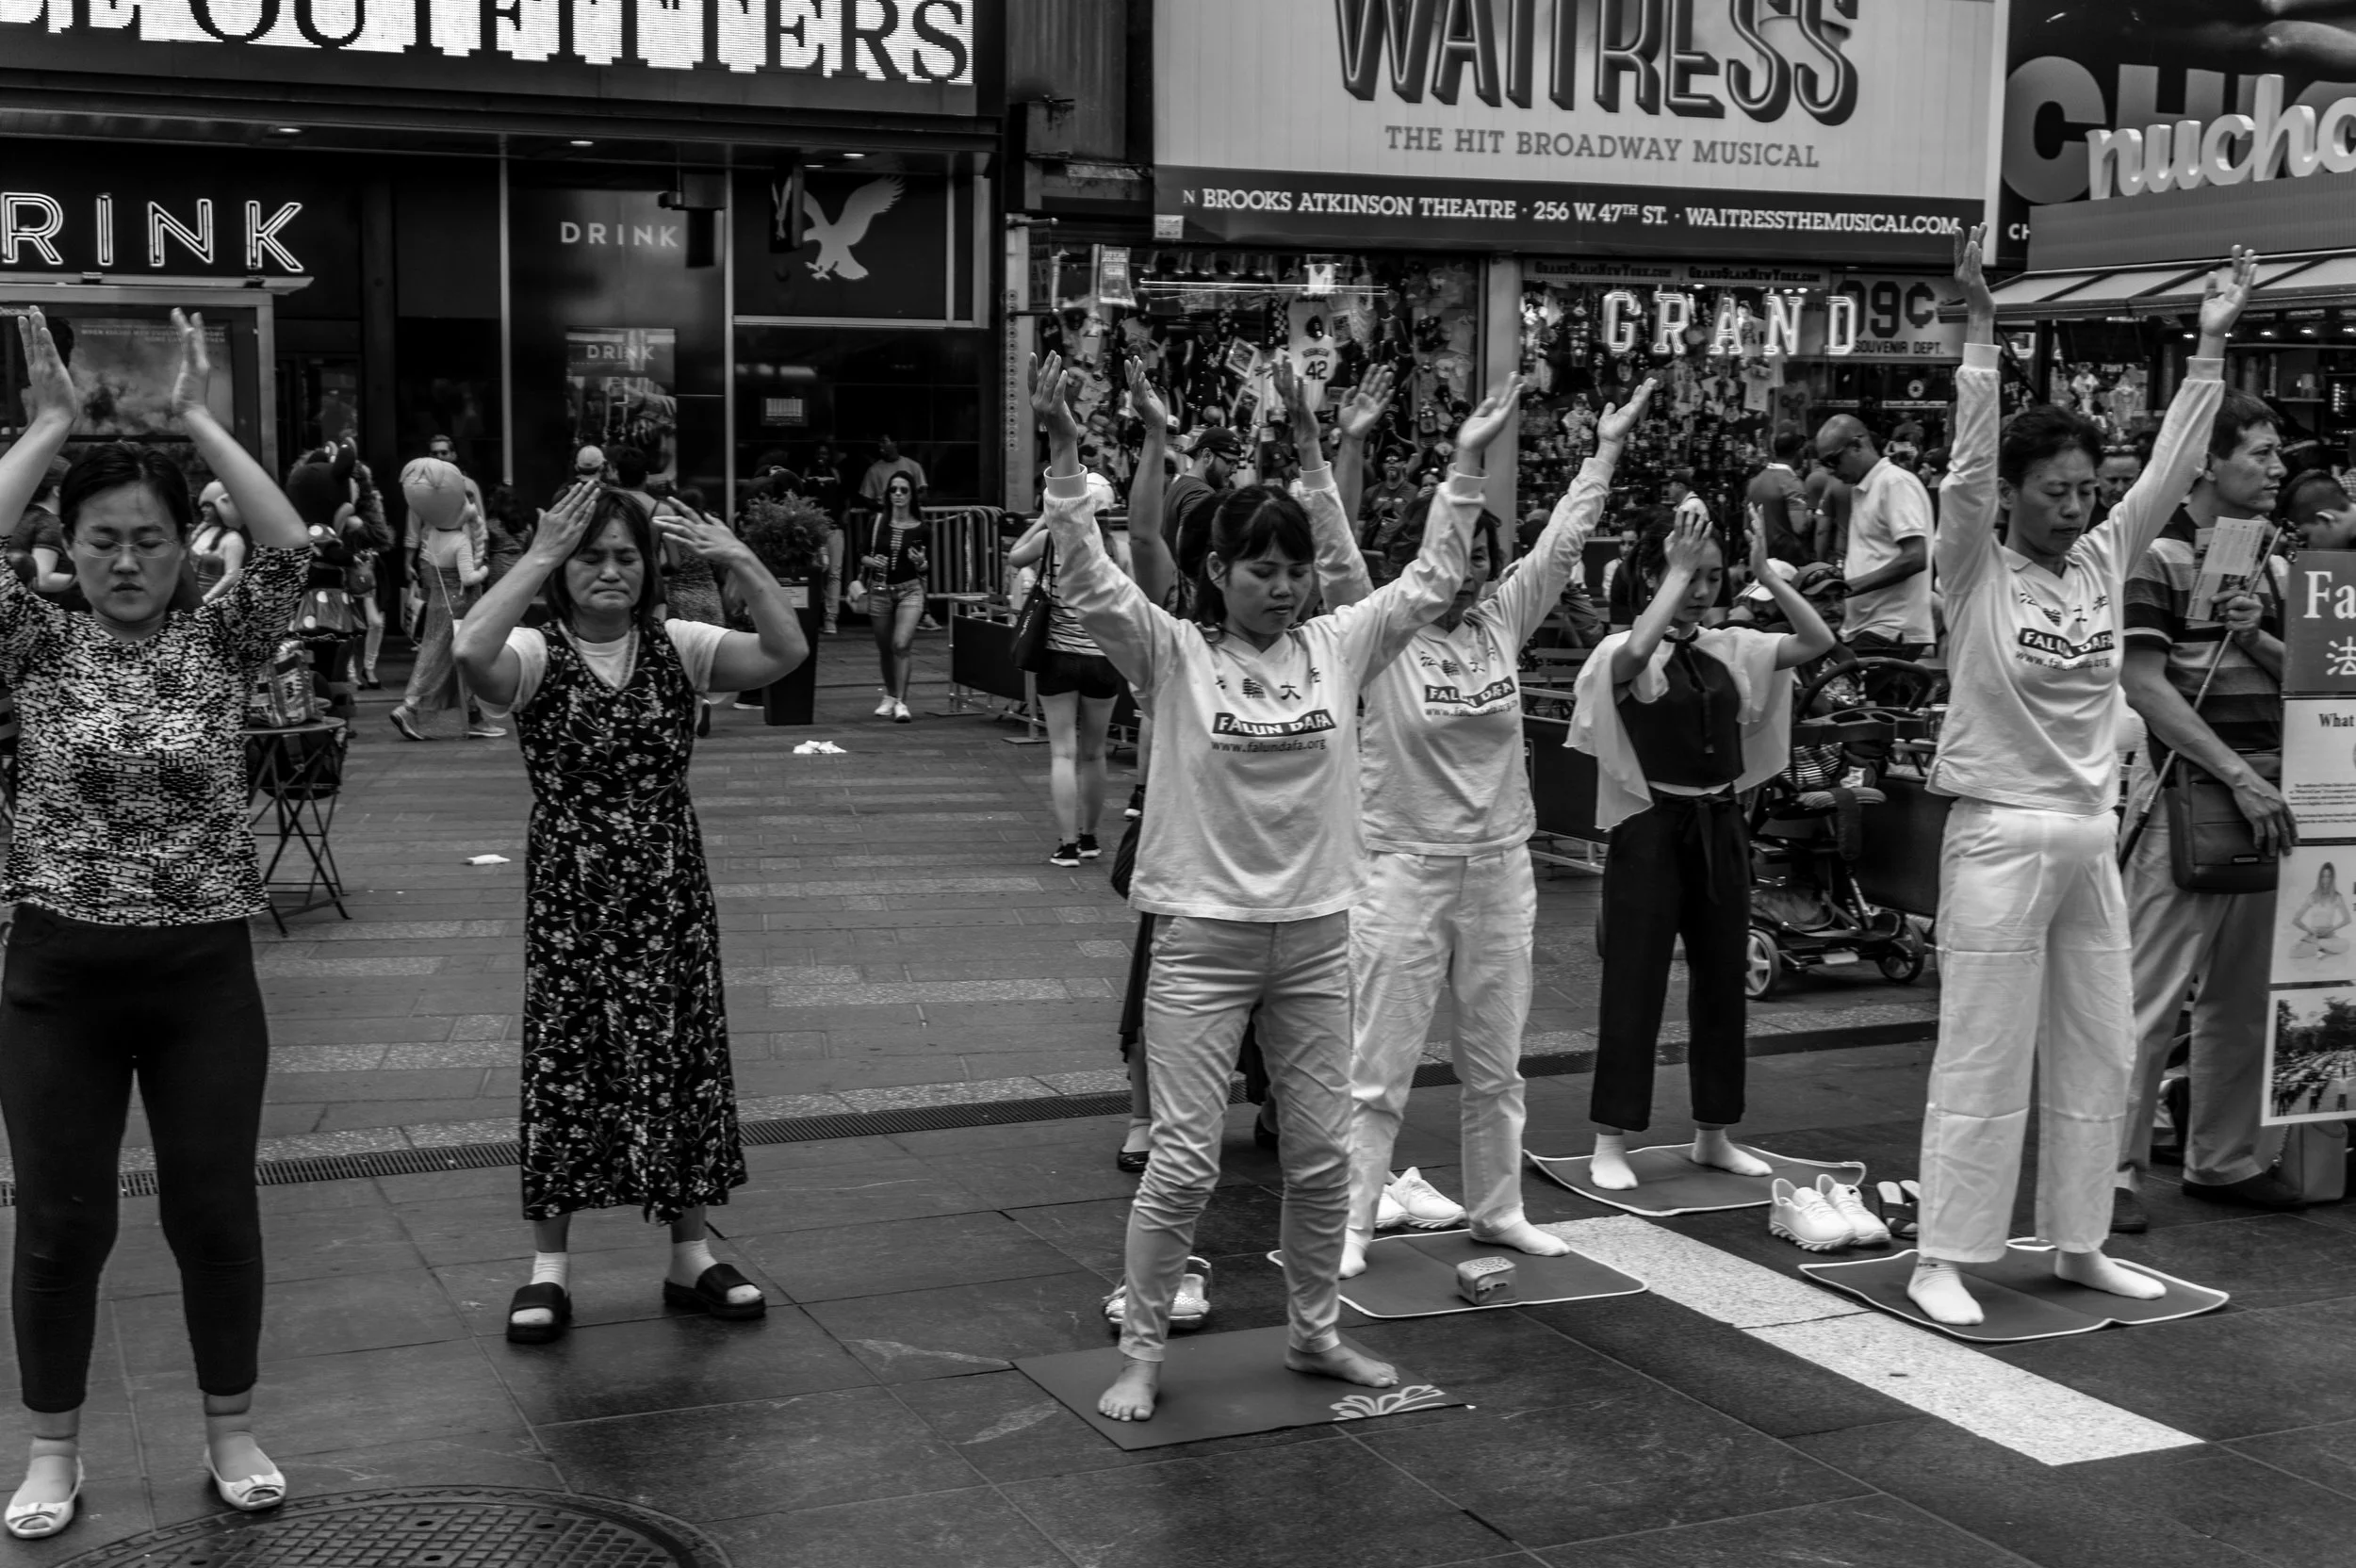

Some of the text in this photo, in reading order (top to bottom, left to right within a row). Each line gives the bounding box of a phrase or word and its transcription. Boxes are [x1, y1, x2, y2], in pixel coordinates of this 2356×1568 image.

[1333, 0, 1858, 126] WAITRESS
[1384, 125, 1820, 168] THE HIT BROADWAY MUSICAL
[1202, 188, 1292, 210] BROOKS
[1297, 192, 1415, 217] ATKINSON
[1418, 197, 1517, 219] THEATRE
[1533, 201, 1570, 220] 256
[1642, 204, 1668, 224] ST.
[1685, 207, 1959, 235] WAITRESSTHEMUSICAL.COM
[560, 221, 679, 247] DRINK
[1605, 289, 1857, 355] GRAND
[586, 344, 655, 360] DRINK
[1854, 340, 1945, 354] SOUVENIR DEPT.
[1305, 360, 1328, 380] 42
[1218, 713, 1333, 735] FALUN DAFA
[2317, 711, 2355, 727] What
